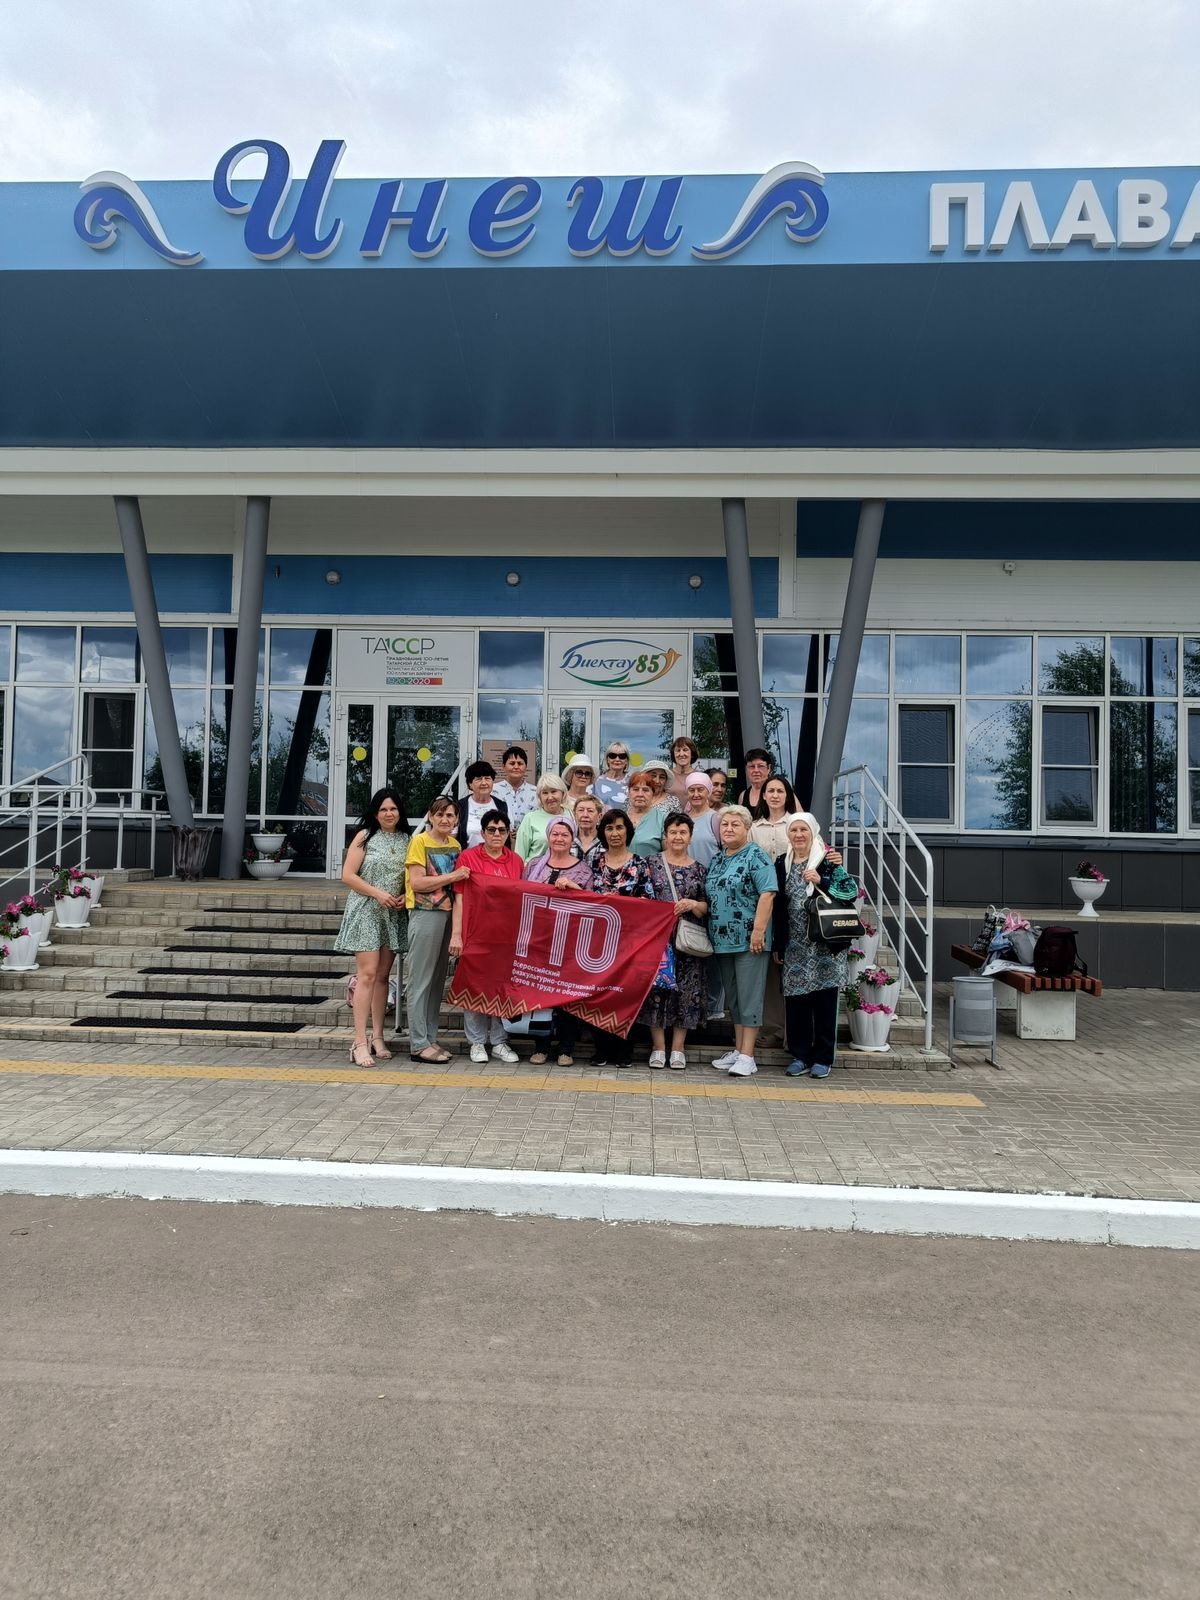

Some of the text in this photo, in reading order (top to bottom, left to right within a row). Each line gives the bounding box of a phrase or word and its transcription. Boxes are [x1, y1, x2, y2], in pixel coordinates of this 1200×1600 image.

[213, 139, 684, 260] Инеш
[560, 651, 661, 675] Биектау 85
[515, 892, 622, 974] ГТО
[511, 968, 595, 991] физкультурно-спортивный
[512, 960, 560, 978] Всероссийский
[536, 982, 554, 993] труду
